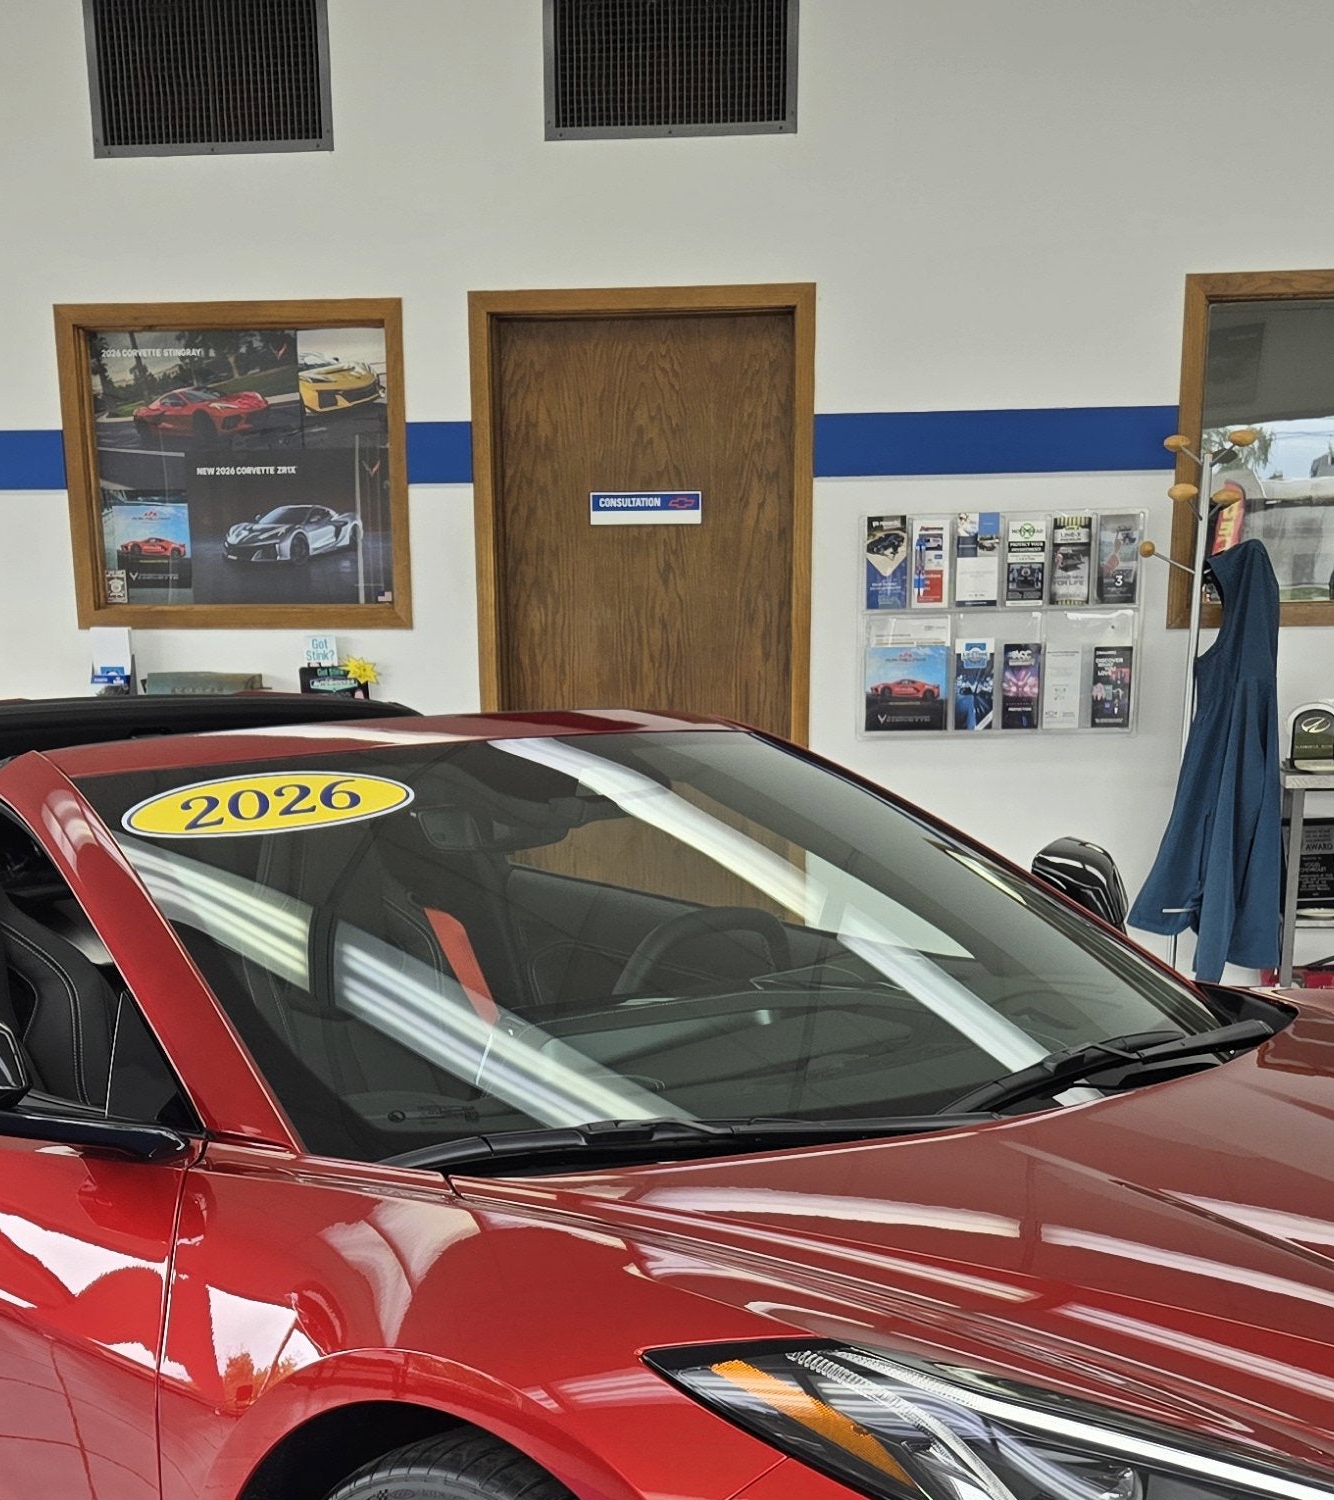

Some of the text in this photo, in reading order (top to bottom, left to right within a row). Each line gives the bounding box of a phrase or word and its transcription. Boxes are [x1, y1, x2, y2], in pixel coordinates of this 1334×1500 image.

[101, 349, 201, 358] 2026 CORVETTE STINGRAY
[196, 467, 215, 475] NEW
[216, 467, 235, 475] 2026
[236, 466, 275, 475] CORVETTE
[598, 497, 661, 507] CONSULTATION
[1114, 575, 1123, 587] 3
[311, 638, 328, 649] Got
[306, 650, 334, 661] Stink?
[180, 779, 361, 831] 2026
